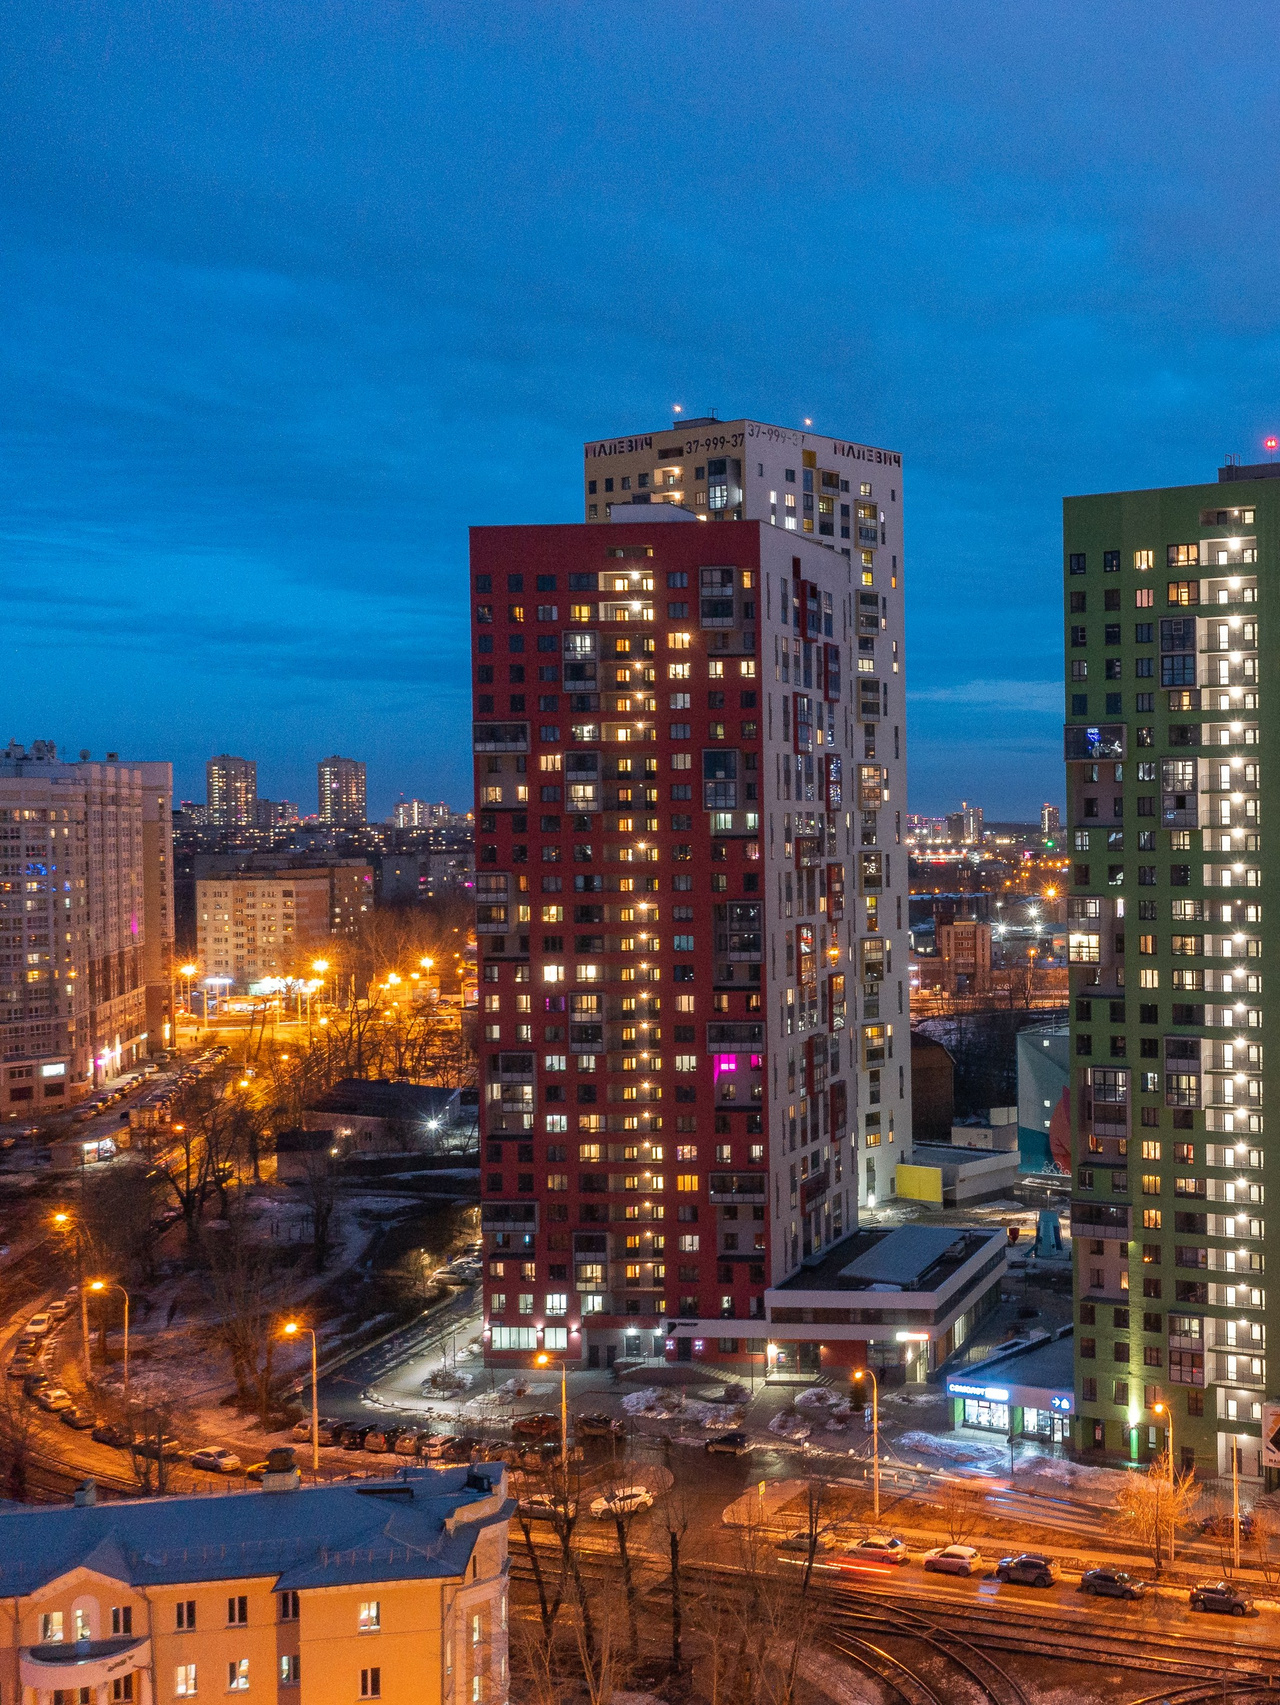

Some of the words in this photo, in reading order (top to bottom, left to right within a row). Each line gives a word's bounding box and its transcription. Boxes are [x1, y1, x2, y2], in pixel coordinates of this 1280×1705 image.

[585, 436, 653, 458] МАЛЕВИЧ
[685, 433, 745, 454] 37-999-37
[833, 442, 901, 468] МАЛЕВИЧ
